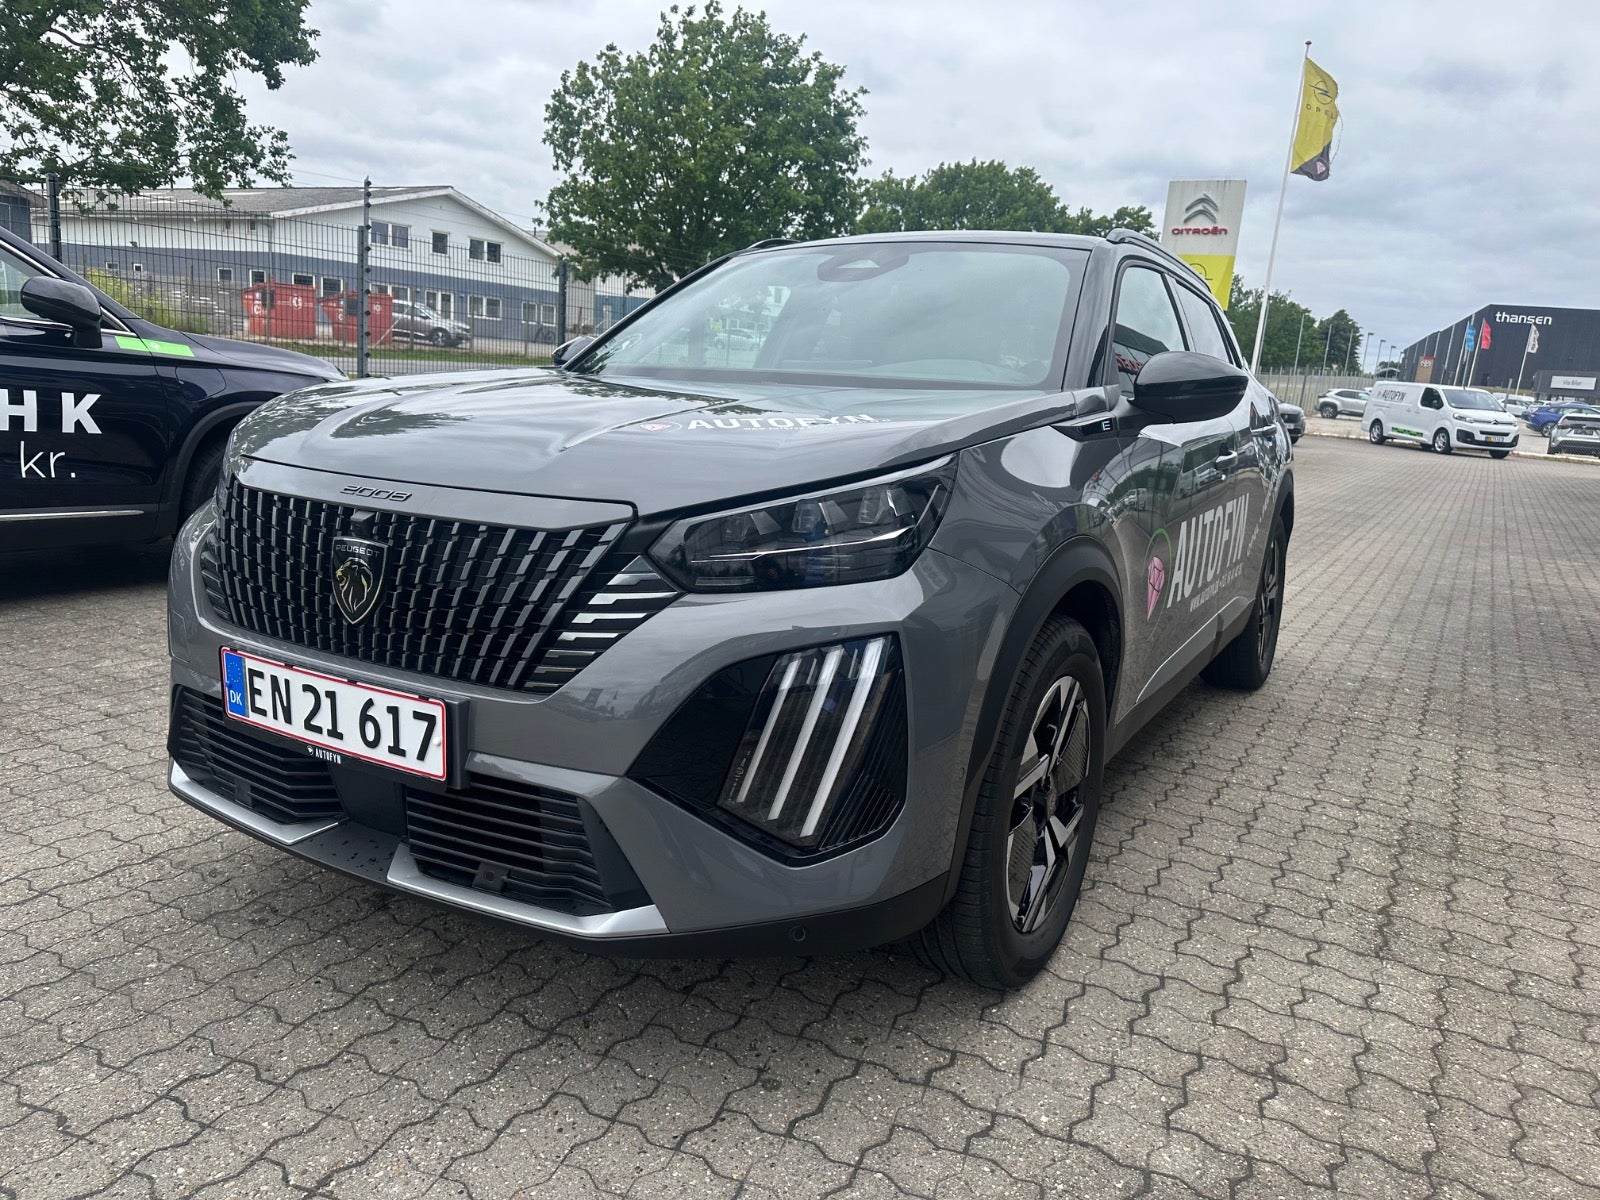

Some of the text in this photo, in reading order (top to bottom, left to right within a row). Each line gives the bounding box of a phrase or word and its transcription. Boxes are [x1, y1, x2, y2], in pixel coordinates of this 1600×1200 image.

[1306, 103, 1336, 120] OPEL
[1171, 225, 1229, 236] CITROËN
[1495, 311, 1553, 326] thansen
[1382, 389, 1406, 401] AUTOFYN
[687, 414, 878, 431] AUTOFYN
[1101, 420, 1111, 431] E
[20, 440, 76, 478] kr.
[340, 485, 413, 502] 2008
[336, 544, 380, 557] PEUGEOT
[1166, 493, 1249, 609] AUTOFYN
[230, 689, 243, 706] DK
[248, 667, 437, 762] EN 21 617
[315, 747, 342, 765] AUTOFYN
